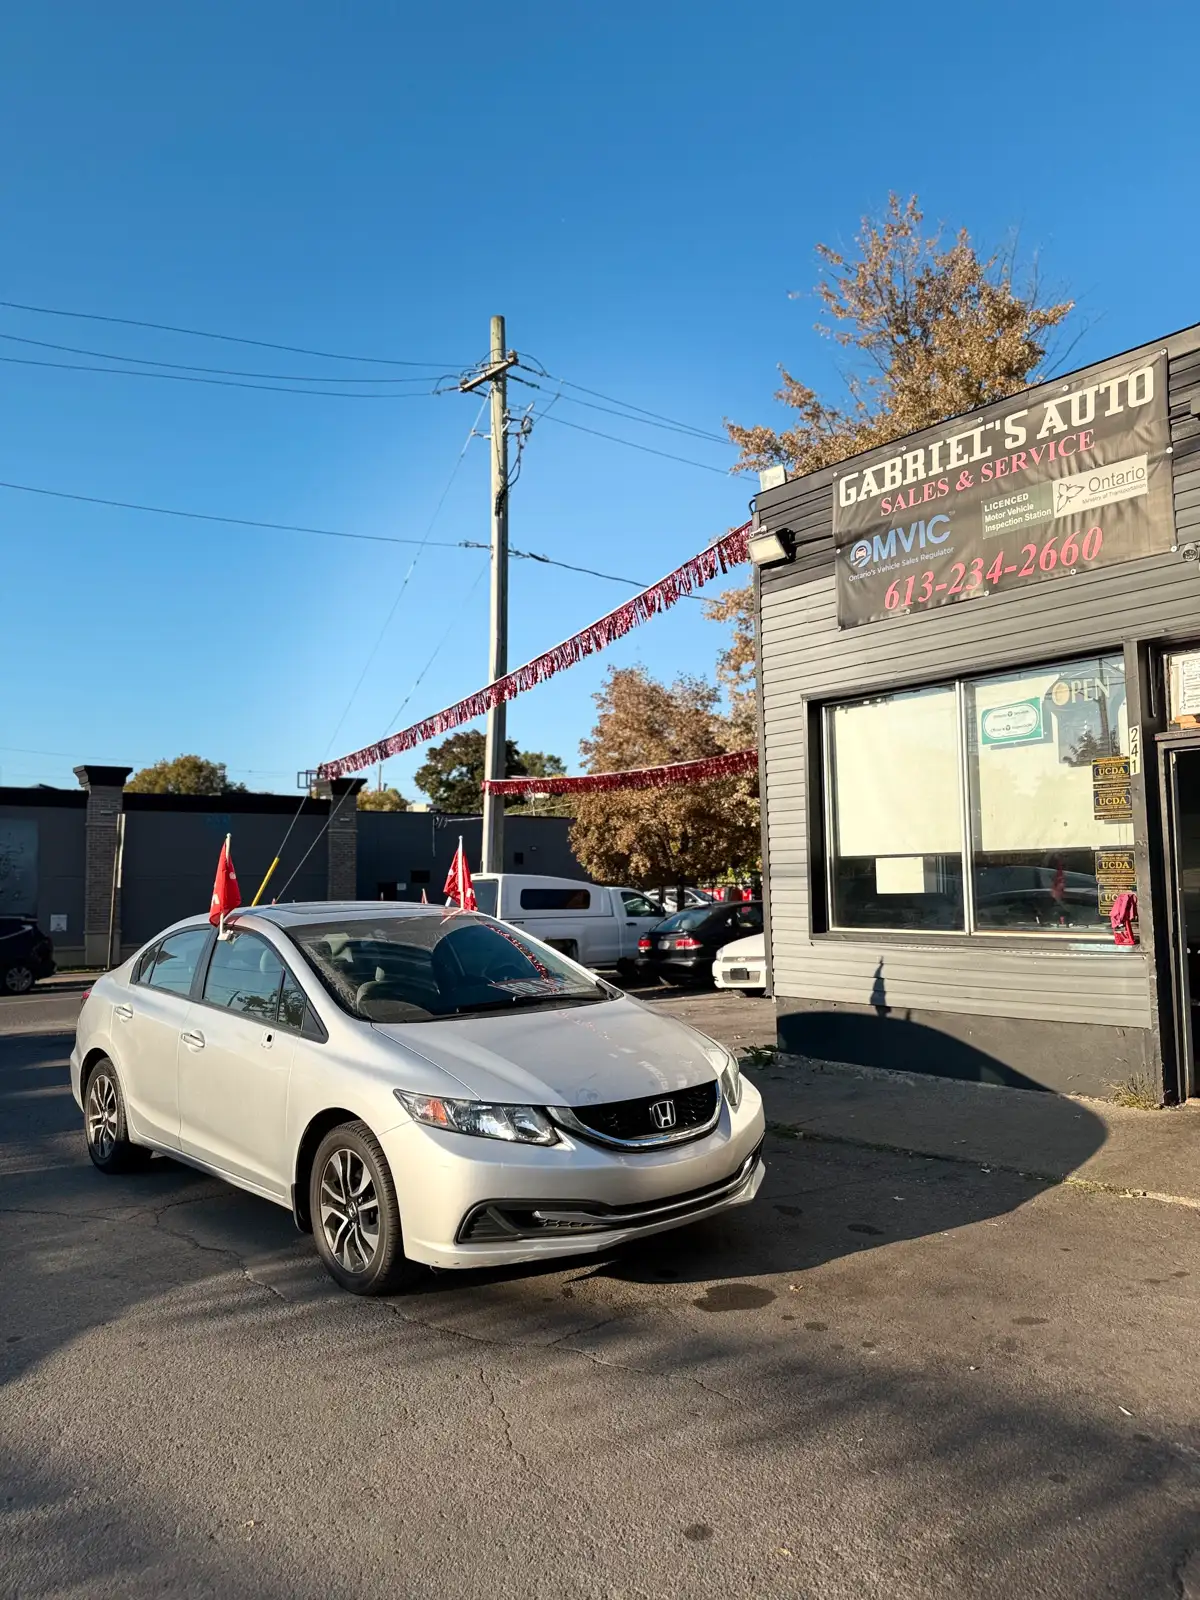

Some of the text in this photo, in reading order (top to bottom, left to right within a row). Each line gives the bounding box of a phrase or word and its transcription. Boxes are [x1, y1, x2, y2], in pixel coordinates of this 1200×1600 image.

[1036, 366, 1154, 440] AUTO
[880, 429, 1096, 517] SALES & SERVICE
[1088, 466, 1145, 492] Ontario
[984, 492, 1029, 513] LICENCED
[984, 503, 1035, 523] Motor Vehicle
[984, 508, 1052, 533] Inspection Station
[850, 513, 951, 568] OMVIC
[848, 546, 955, 582] Ontario's Vehicle Sales Regulator
[884, 526, 1103, 610] 613-234-2660
[1098, 766, 1126, 776] UCDA
[1098, 796, 1127, 806] UCDA
[1101, 861, 1130, 869] UCDA
